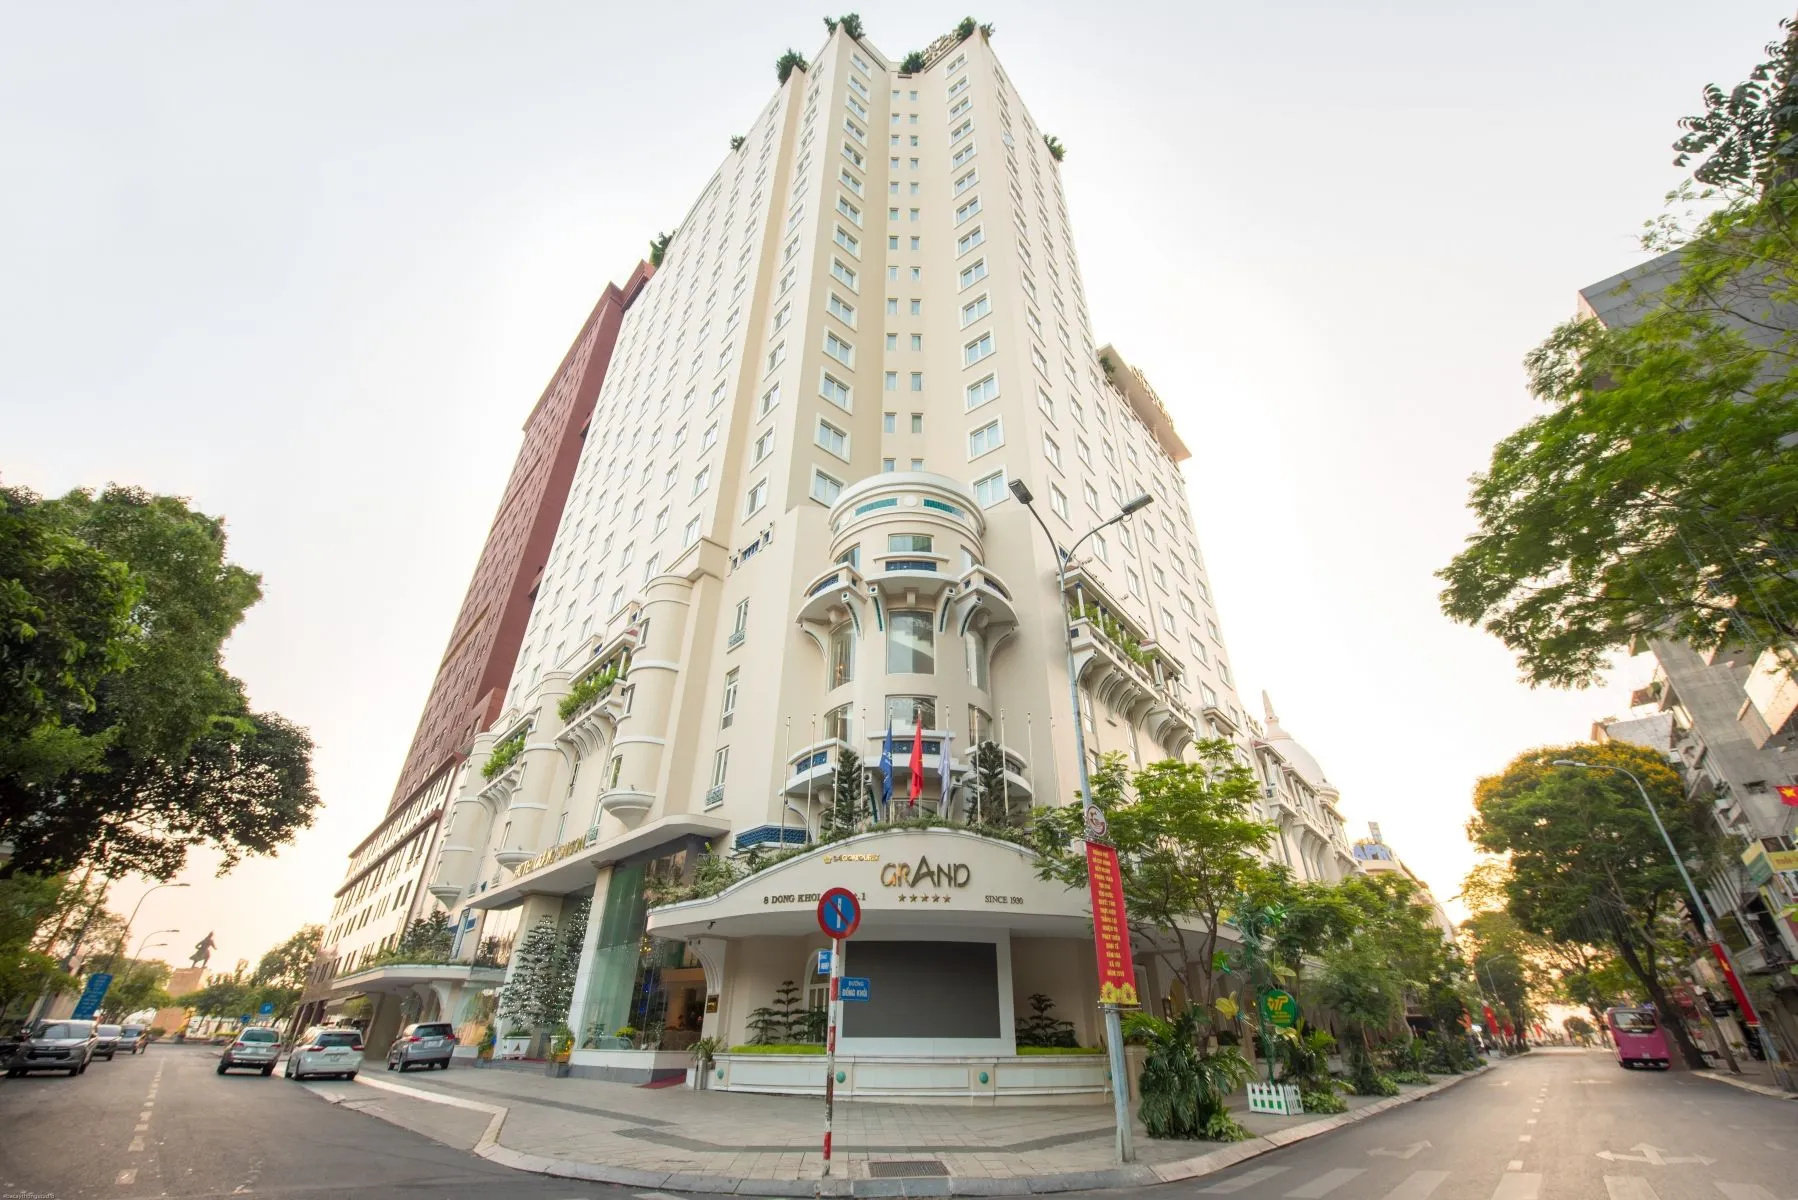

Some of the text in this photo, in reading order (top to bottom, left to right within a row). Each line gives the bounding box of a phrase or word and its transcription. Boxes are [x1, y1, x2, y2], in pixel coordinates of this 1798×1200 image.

[880, 855, 970, 888] GRAND
[763, 893, 821, 904] 8 DONG KHOI
[984, 895, 1008, 904] SINCE
